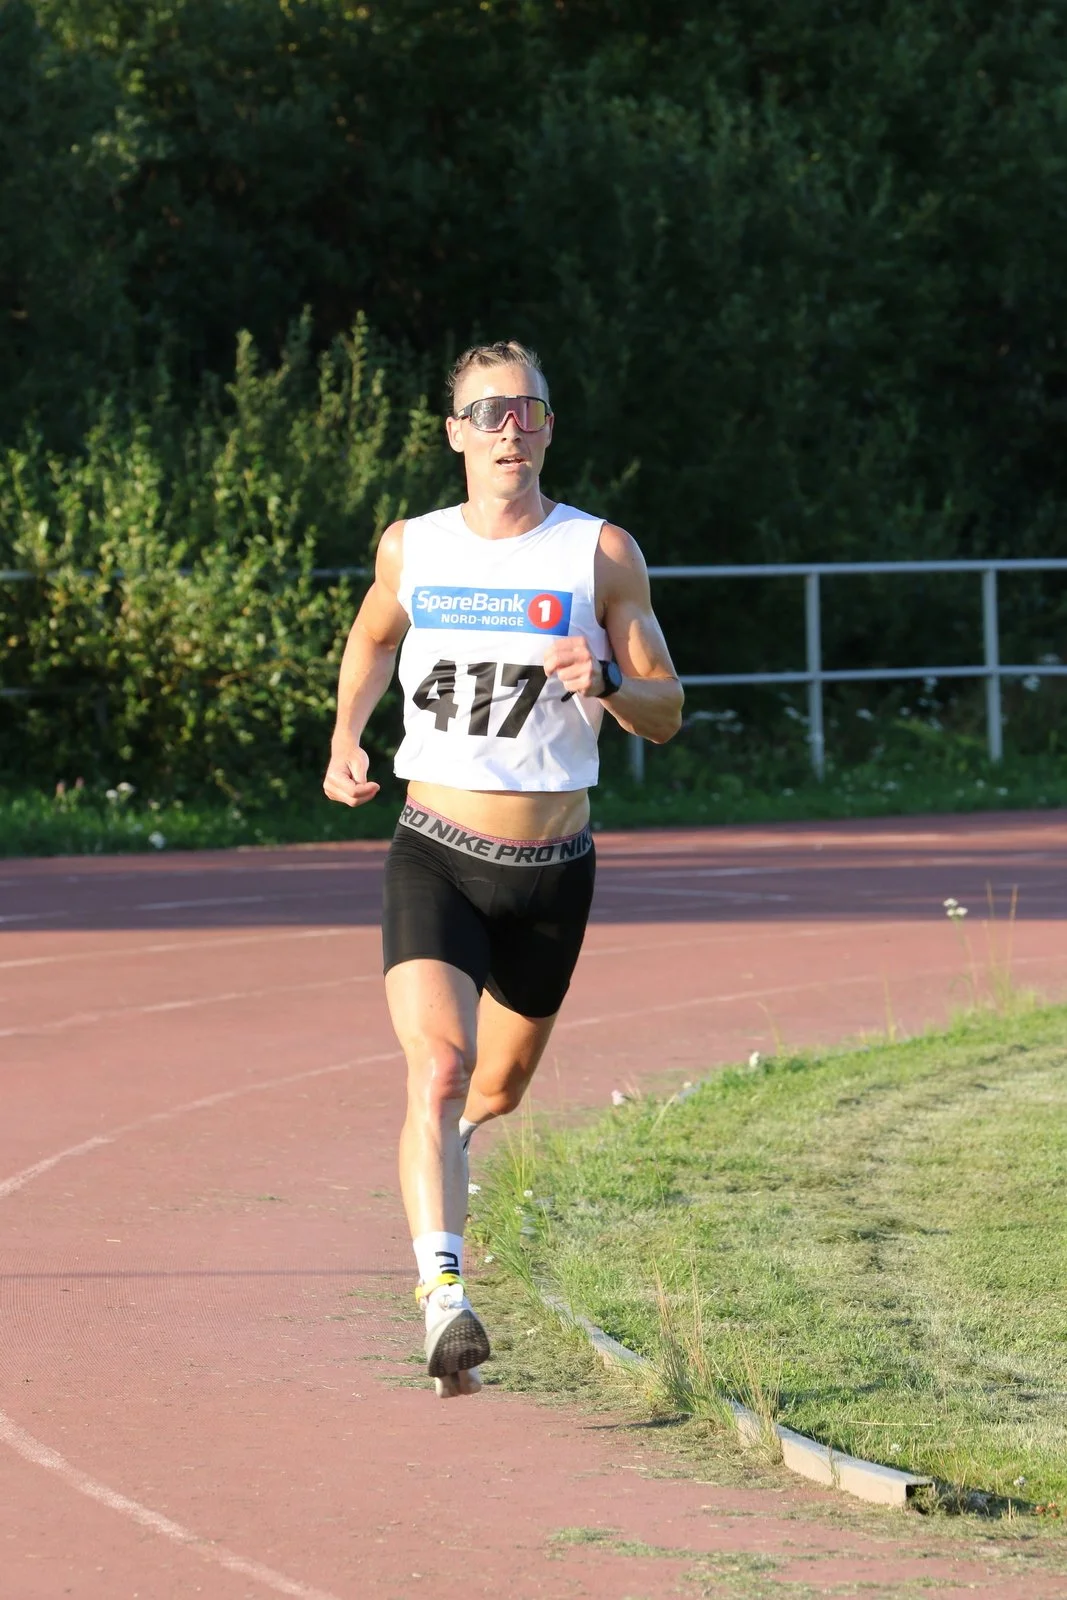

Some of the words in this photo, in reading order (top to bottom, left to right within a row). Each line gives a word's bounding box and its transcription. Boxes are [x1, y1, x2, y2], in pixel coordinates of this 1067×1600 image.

[416, 590, 526, 613] SpareBank
[537, 599, 552, 623] 1
[441, 613, 524, 627] NORD-NORGE
[412, 659, 578, 739] 417
[401, 804, 429, 828] RO
[427, 819, 494, 857] NIKE
[494, 845, 555, 863] PRO
[560, 830, 592, 860] NIK
